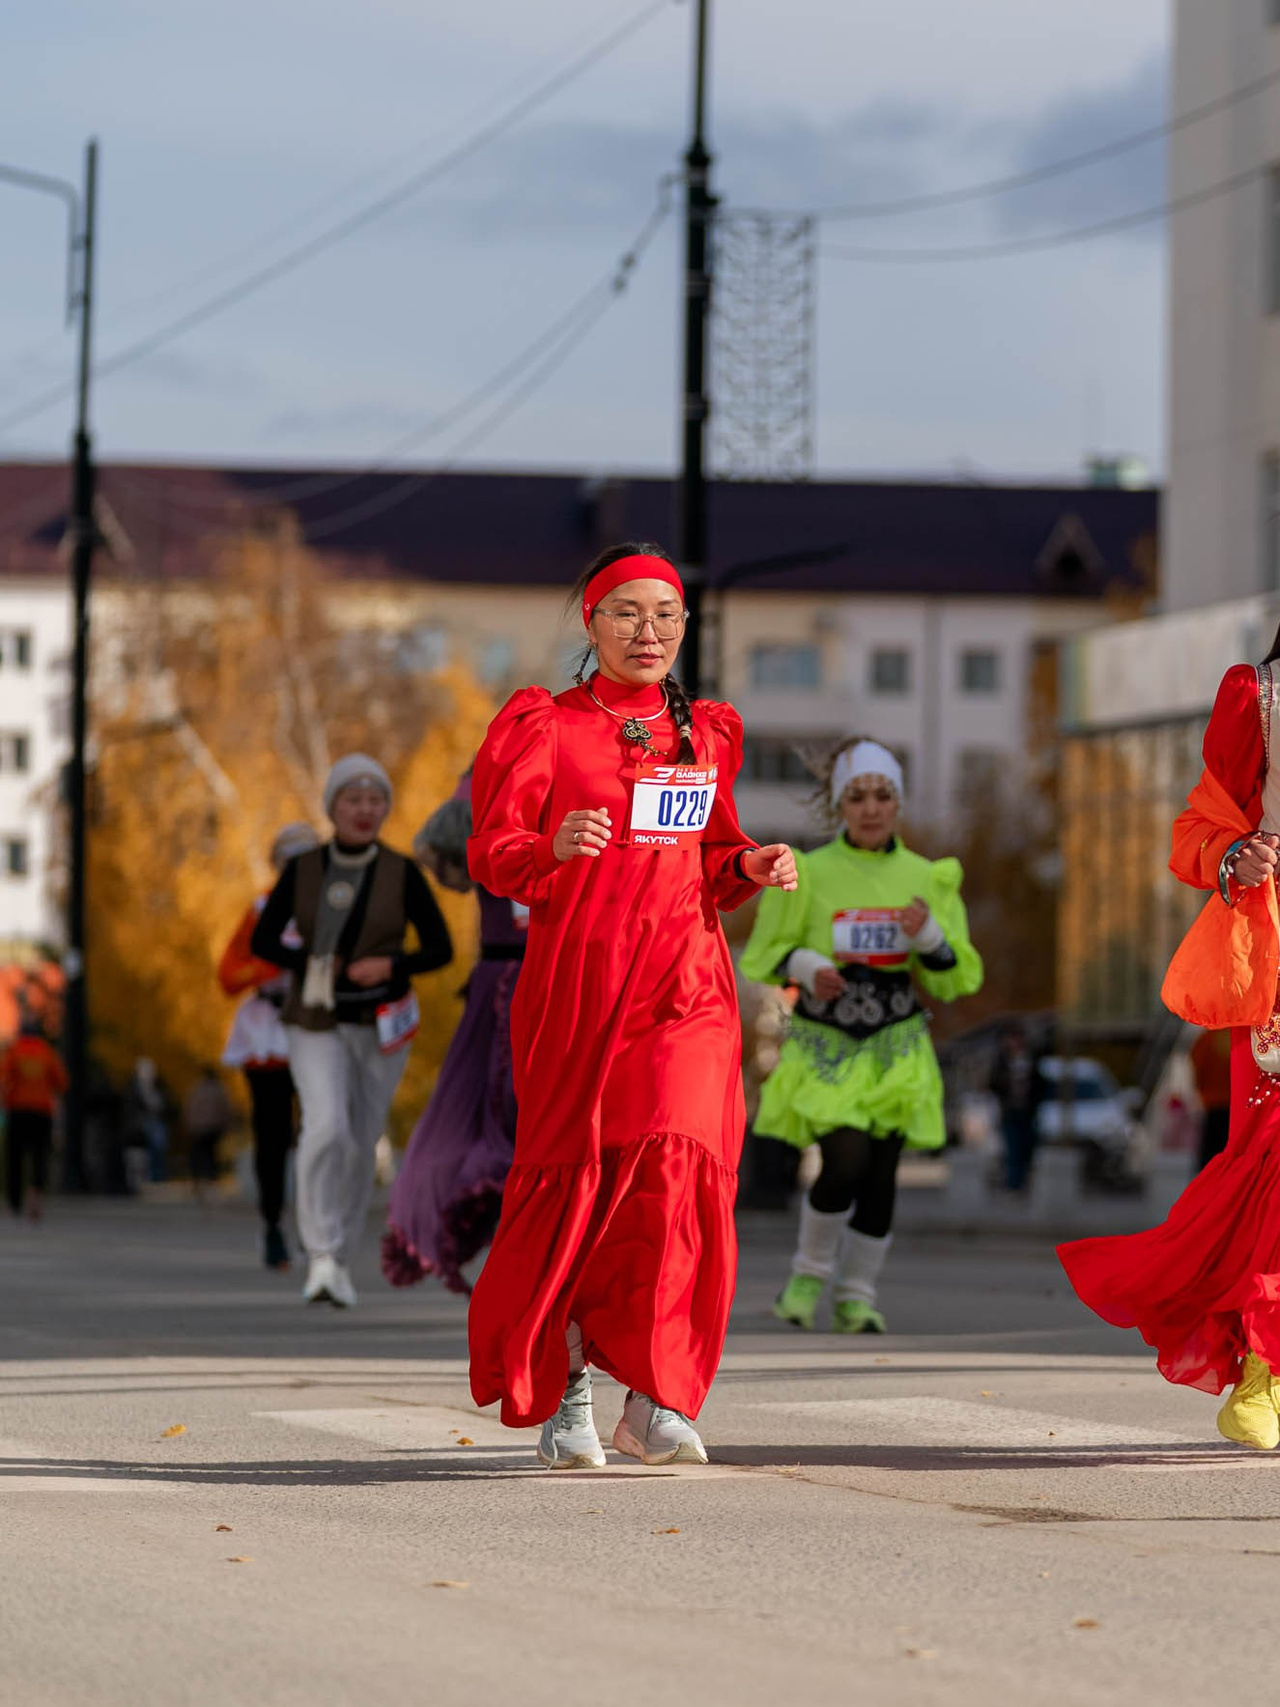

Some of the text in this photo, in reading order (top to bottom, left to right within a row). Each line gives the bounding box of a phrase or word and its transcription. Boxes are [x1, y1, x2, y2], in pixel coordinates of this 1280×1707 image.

[658, 790, 708, 827] 0229
[634, 835, 678, 845] ЯКУТСК
[851, 923, 897, 949] 0262
